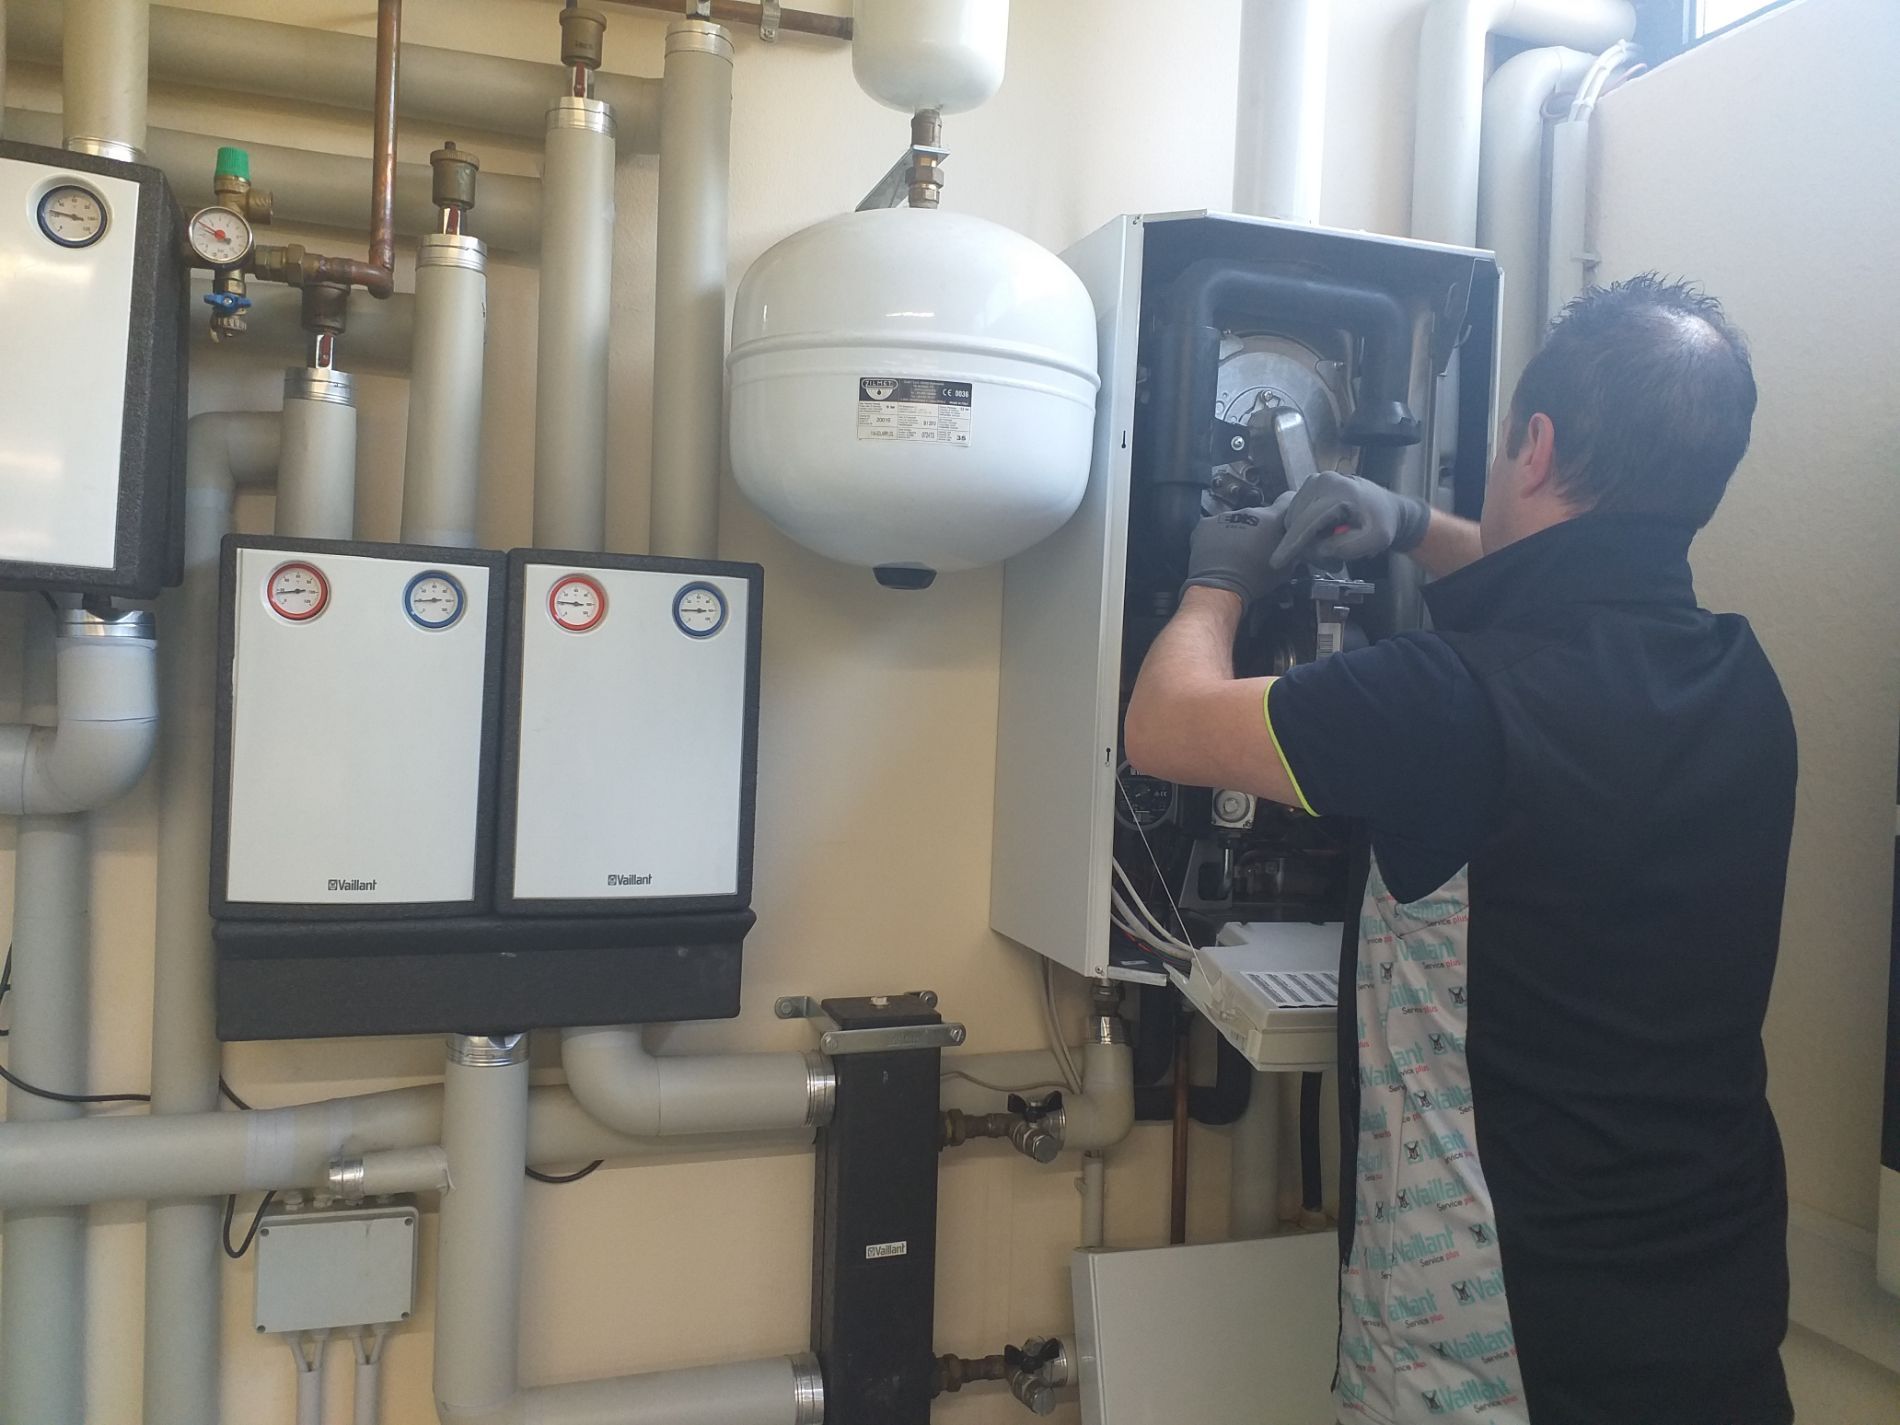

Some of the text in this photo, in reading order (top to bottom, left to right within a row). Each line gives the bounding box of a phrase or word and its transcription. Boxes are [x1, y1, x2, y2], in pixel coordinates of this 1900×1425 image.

[338, 879, 377, 891] Vaillant
[617, 874, 652, 886] Vaillant
[1436, 1199, 1463, 1212] Service
[876, 1242, 905, 1257] Vaillant
[1420, 1255, 1444, 1267] Service
